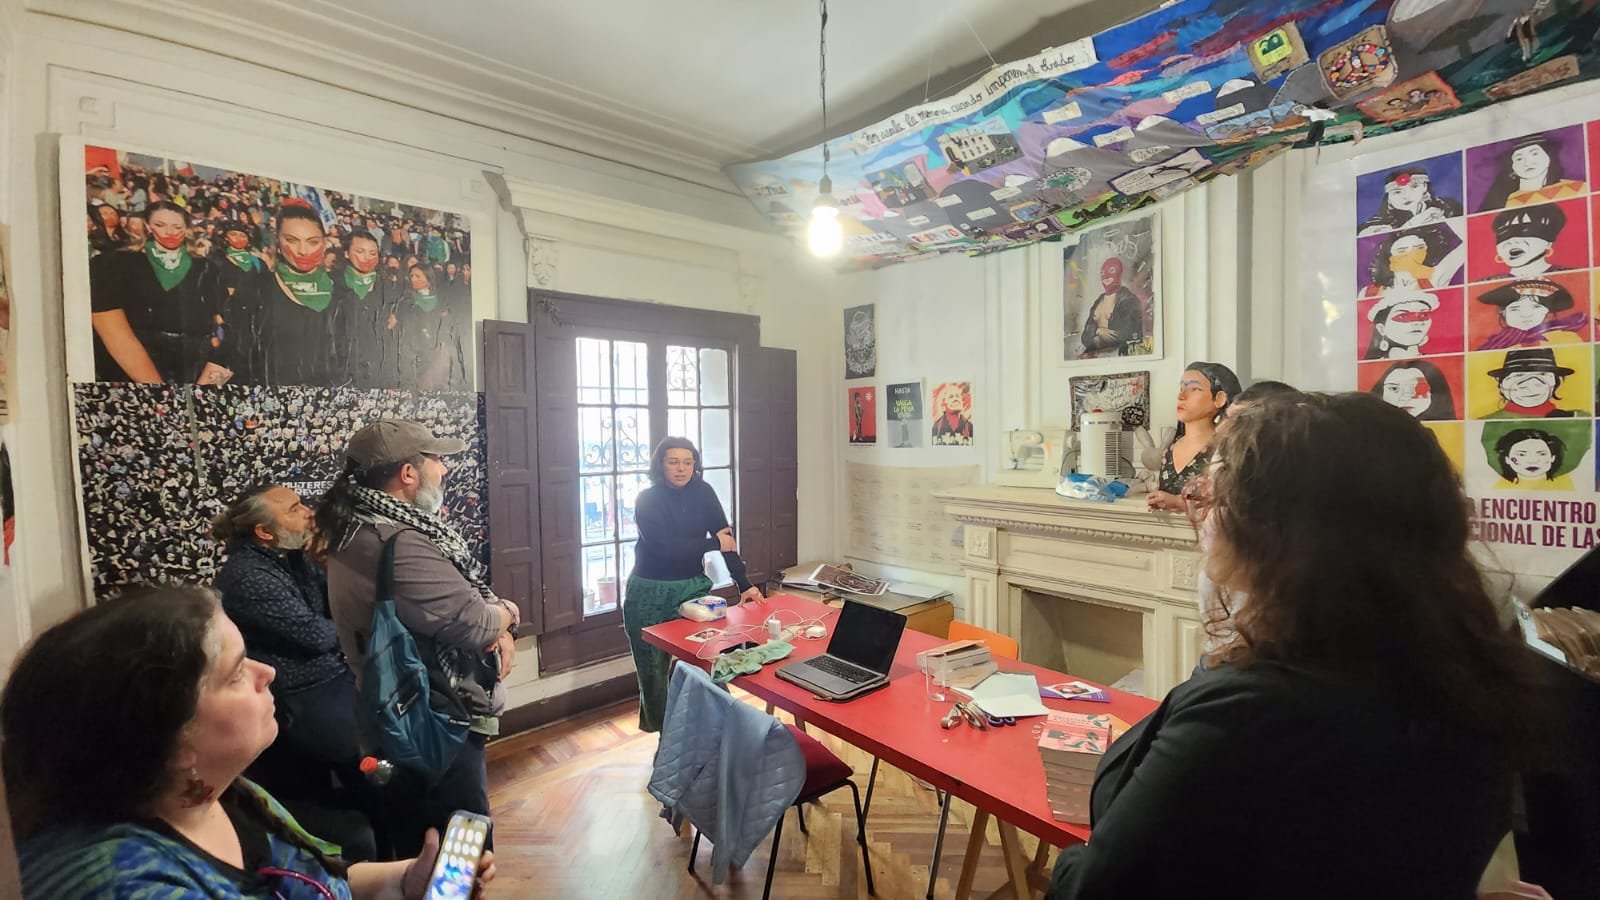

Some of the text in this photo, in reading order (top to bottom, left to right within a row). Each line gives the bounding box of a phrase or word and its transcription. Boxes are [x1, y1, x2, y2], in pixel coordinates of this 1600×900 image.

[282, 481, 335, 489] MUJERES
[1481, 498, 1597, 524] ENCUENTRO
[1470, 521, 1537, 545] CIONAL
[1542, 525, 1566, 547] DE
